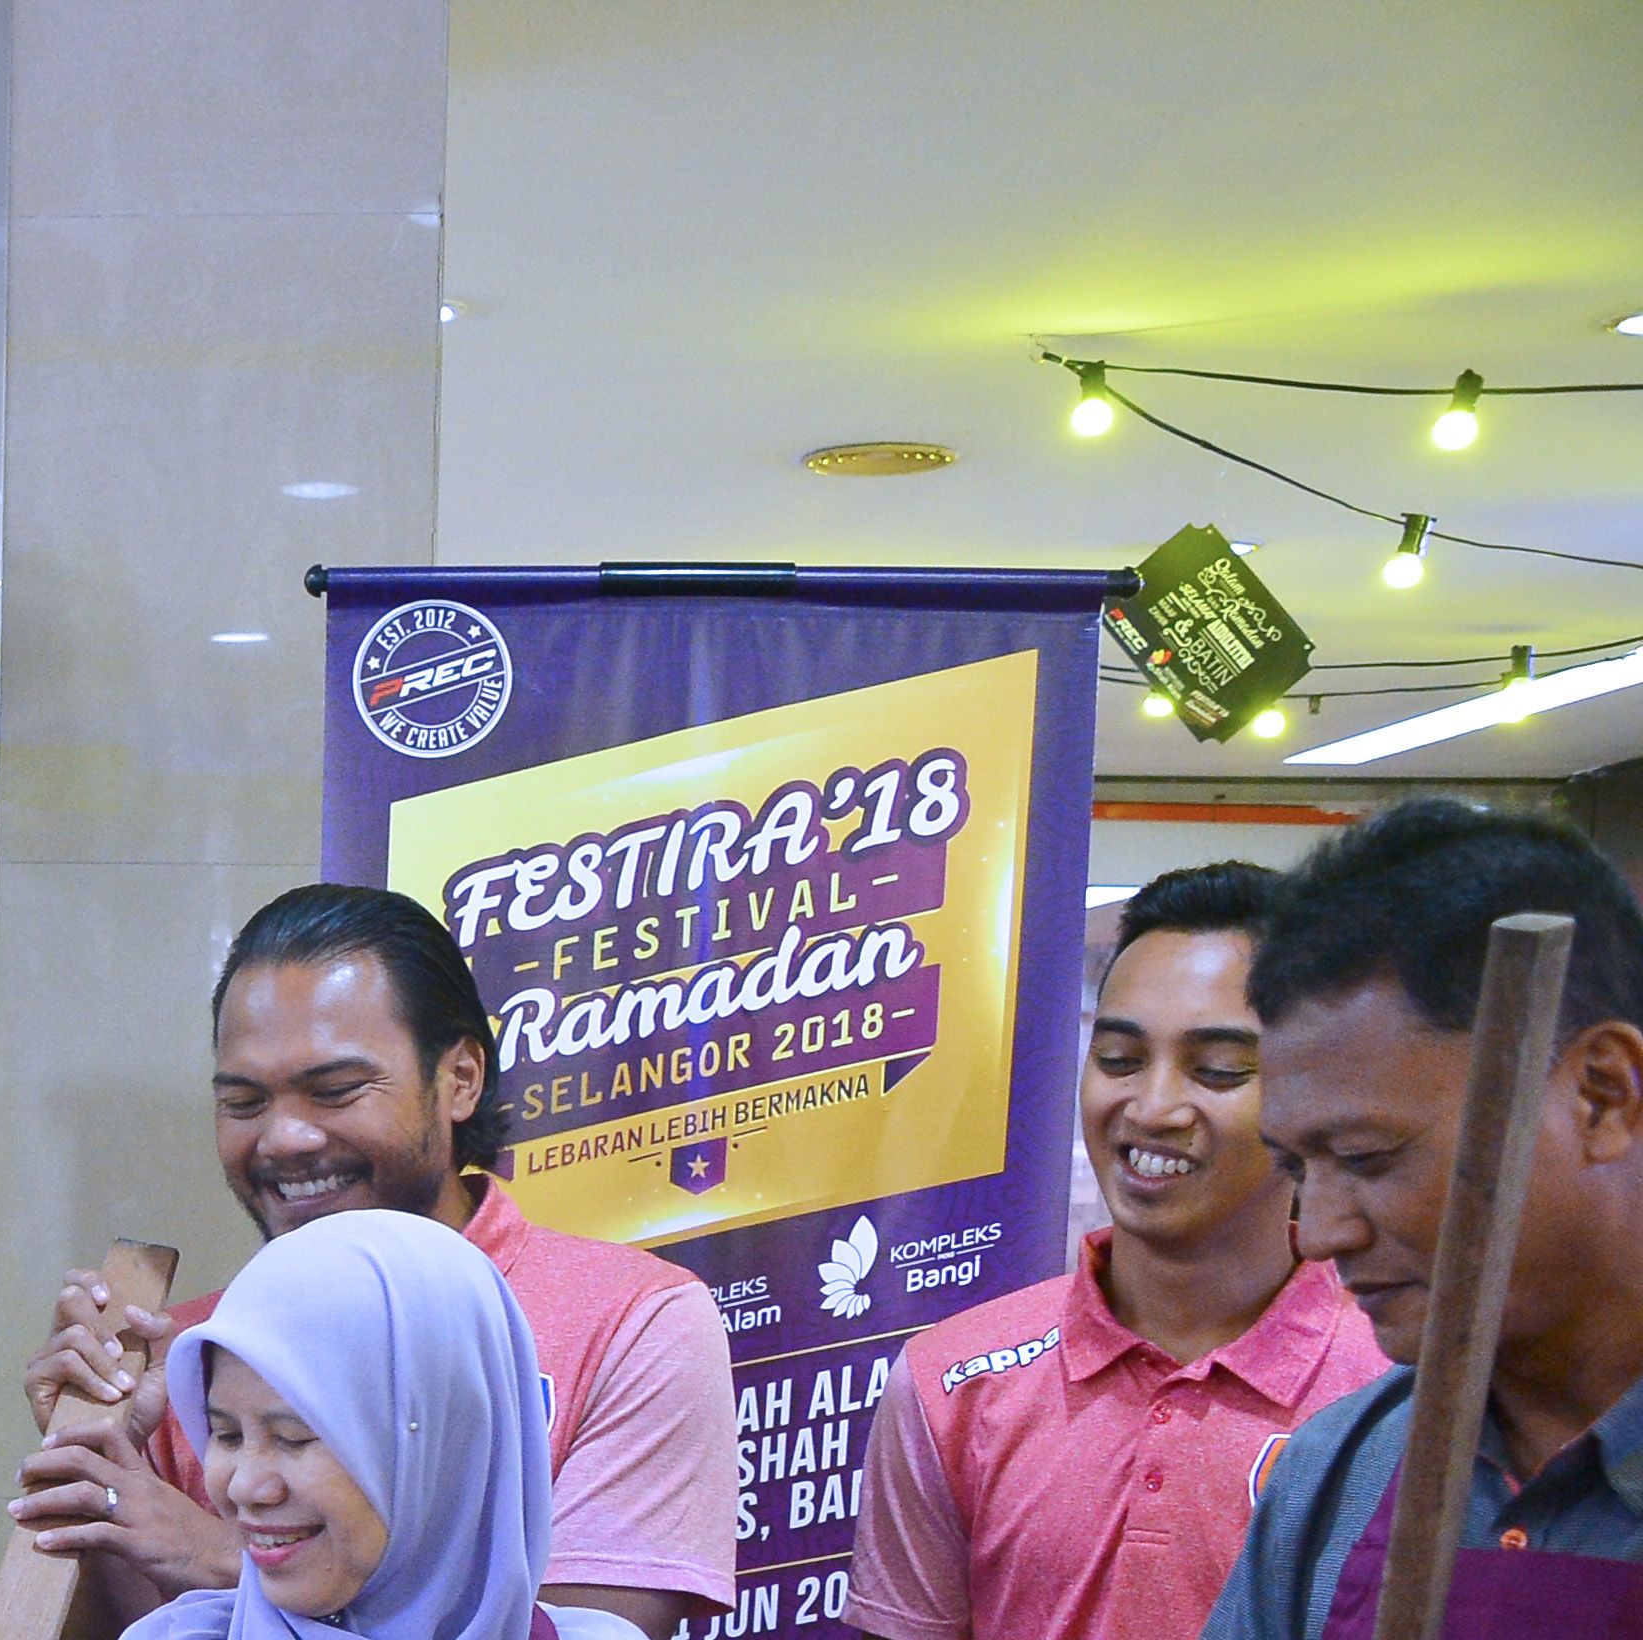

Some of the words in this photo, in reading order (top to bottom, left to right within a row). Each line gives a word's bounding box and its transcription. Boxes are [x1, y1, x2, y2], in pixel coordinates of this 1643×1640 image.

[375, 618, 411, 651] EST.
[413, 608, 457, 630] 2012
[1109, 608, 1148, 652] PREC
[1222, 599, 1264, 649] Ramadan
[369, 648, 497, 706] PREC
[1191, 638, 1235, 687] BATIN
[378, 711, 407, 739] WE
[405, 721, 469, 749] CREATE
[465, 679, 503, 730] VALUE
[453, 757, 962, 947] FESTIRA'18
[552, 872, 858, 979] FESTIVAL
[498, 925, 917, 1075] Ramadan
[522, 1040, 751, 1122] SELANGOR
[772, 1006, 885, 1063] 2018
[527, 1125, 643, 1175] LEBARAN
[649, 1105, 727, 1148] LEBIH
[733, 1073, 870, 1128] BERMAKNA
[890, 1223, 1002, 1263] KOMPLEKS
[906, 1255, 981, 1293] Bangi
[721, 1304, 781, 1333] Alam
[942, 1326, 1061, 1394] Kappa
